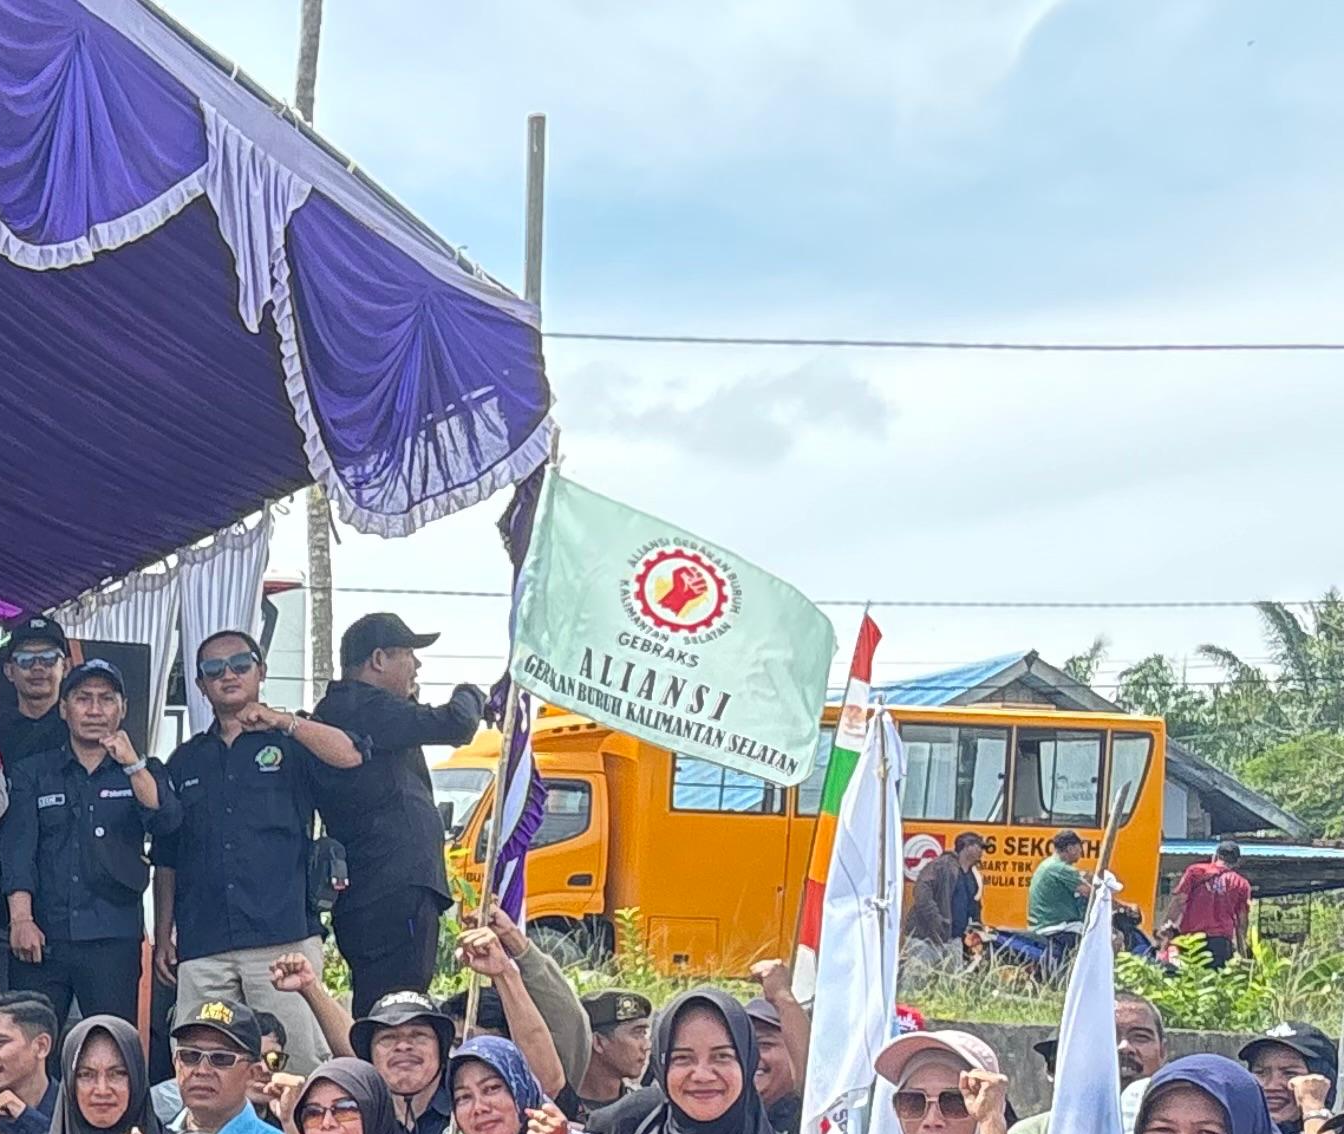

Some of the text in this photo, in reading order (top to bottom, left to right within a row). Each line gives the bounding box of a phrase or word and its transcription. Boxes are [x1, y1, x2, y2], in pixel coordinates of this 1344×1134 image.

[619, 578, 732, 646] KALIMANTAN SELATAN
[578, 646, 732, 722] ALIANSI
[618, 631, 700, 669] GEBRAKS
[576, 680, 623, 718] BURUH
[624, 701, 726, 750] KALIMANTAN
[727, 733, 800, 777] SELATAN
